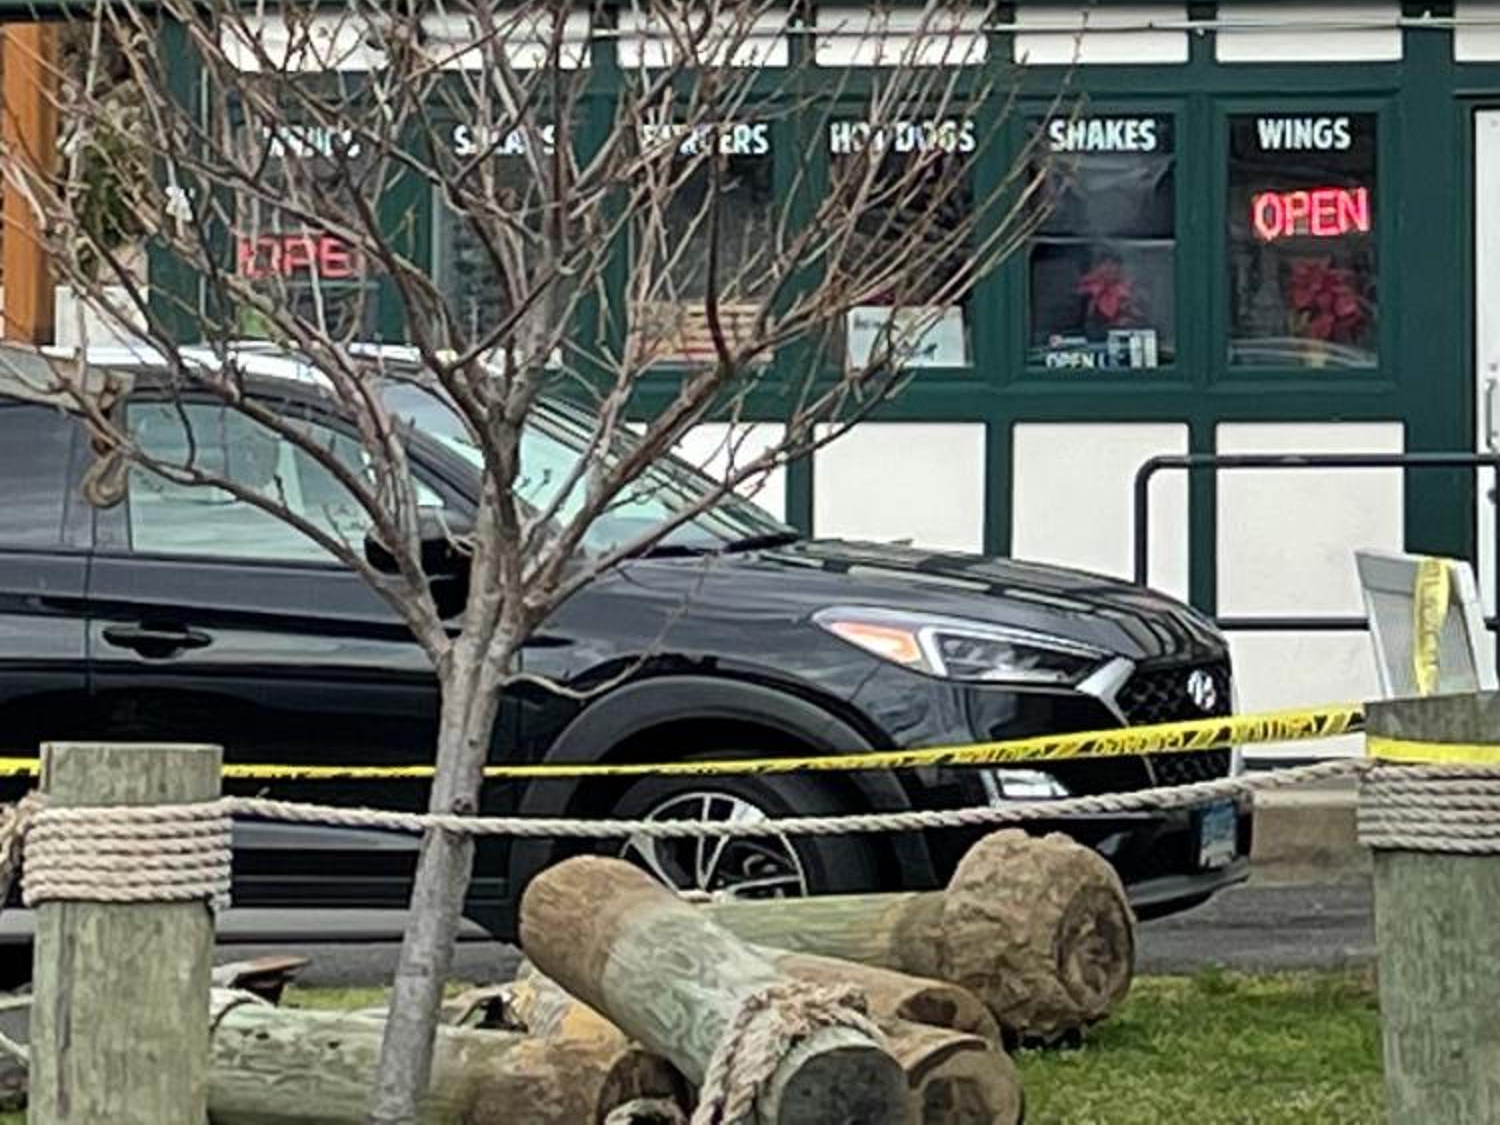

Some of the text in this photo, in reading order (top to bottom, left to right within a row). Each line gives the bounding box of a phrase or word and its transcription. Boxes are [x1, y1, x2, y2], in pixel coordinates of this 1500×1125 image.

[895, 120, 976, 153] DOGS
[1049, 118, 1157, 151] SHAKES
[1257, 117, 1351, 149] WINGS
[1252, 188, 1370, 240] OPEN
